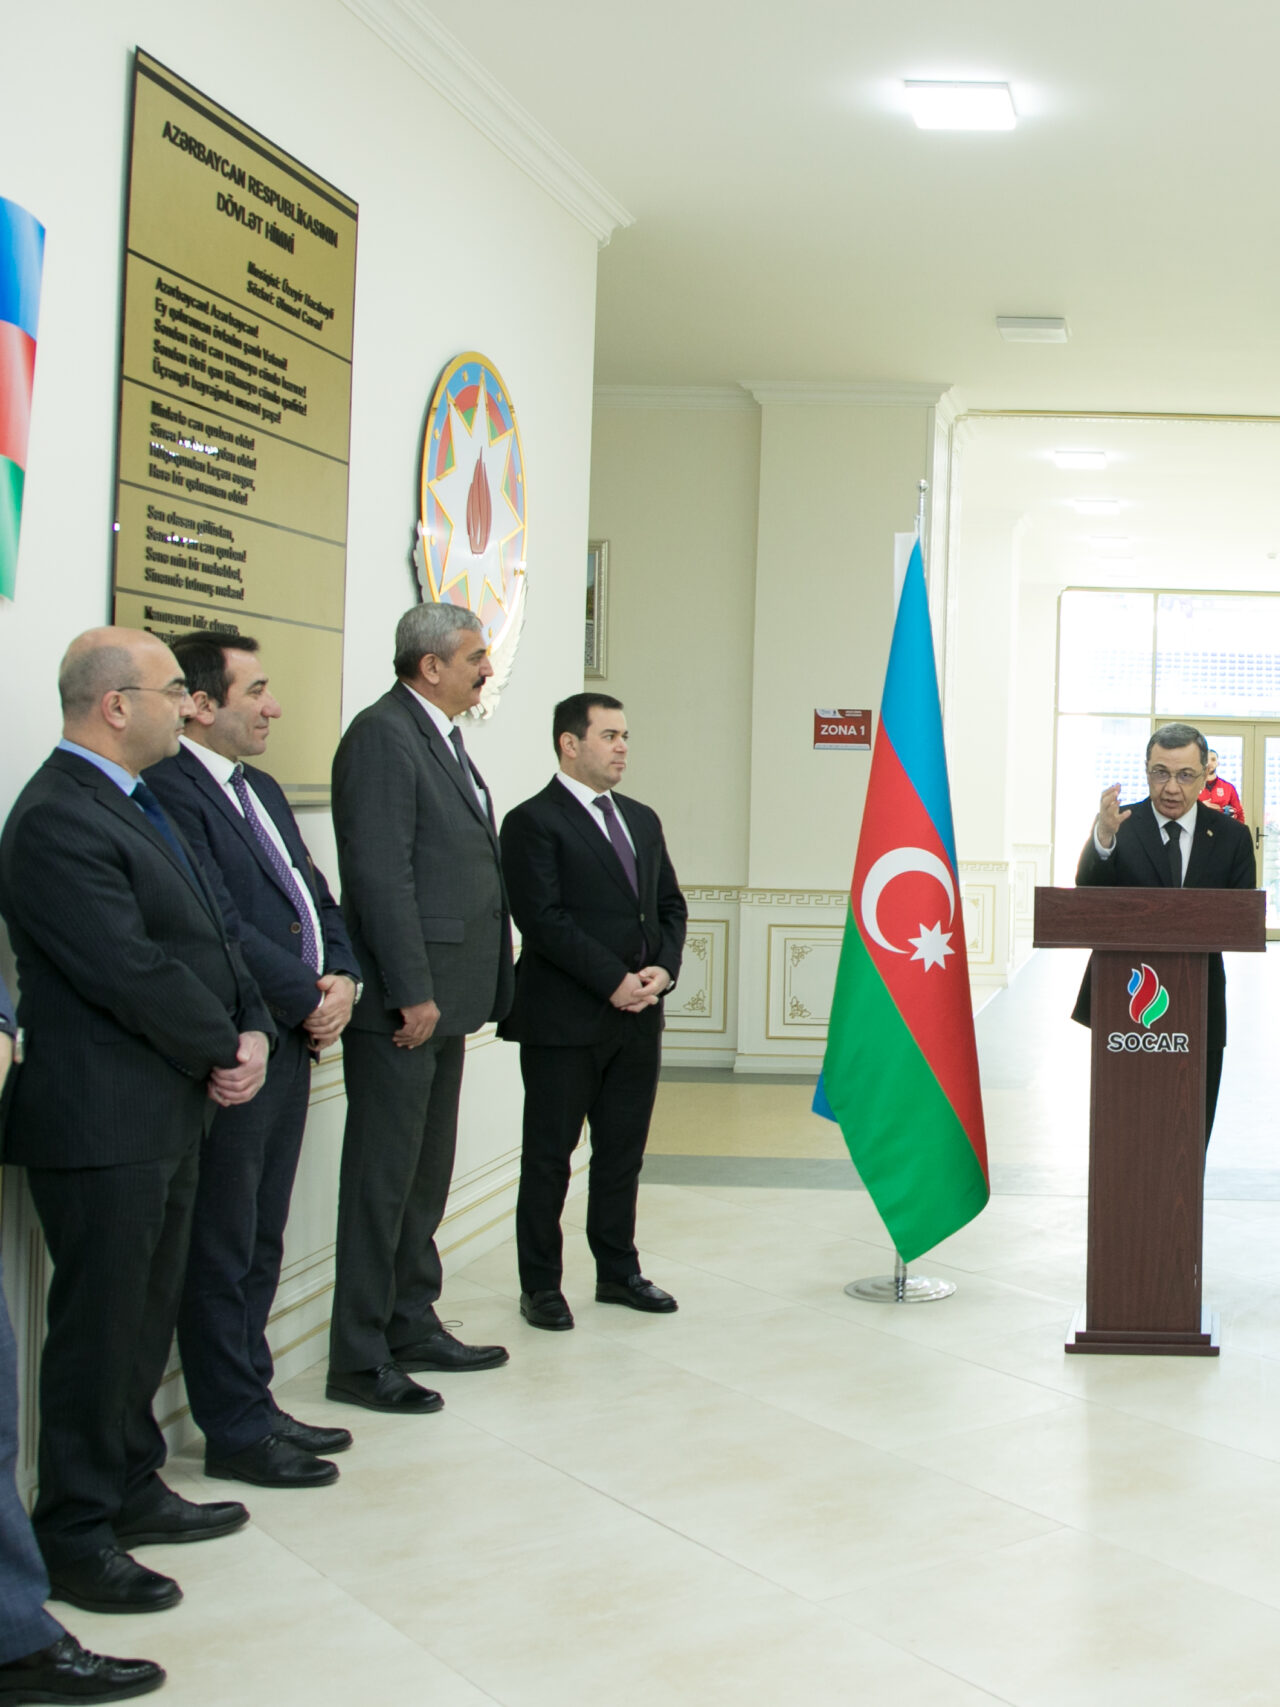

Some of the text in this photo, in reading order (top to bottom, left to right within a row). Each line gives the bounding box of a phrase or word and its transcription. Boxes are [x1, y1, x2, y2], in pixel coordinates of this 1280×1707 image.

[162, 121, 246, 189] AZƏRBAYCAN
[216, 192, 263, 234] DÖVLƏT
[820, 725, 865, 736] ZONA 1
[1107, 1032, 1189, 1053] SOCAR
